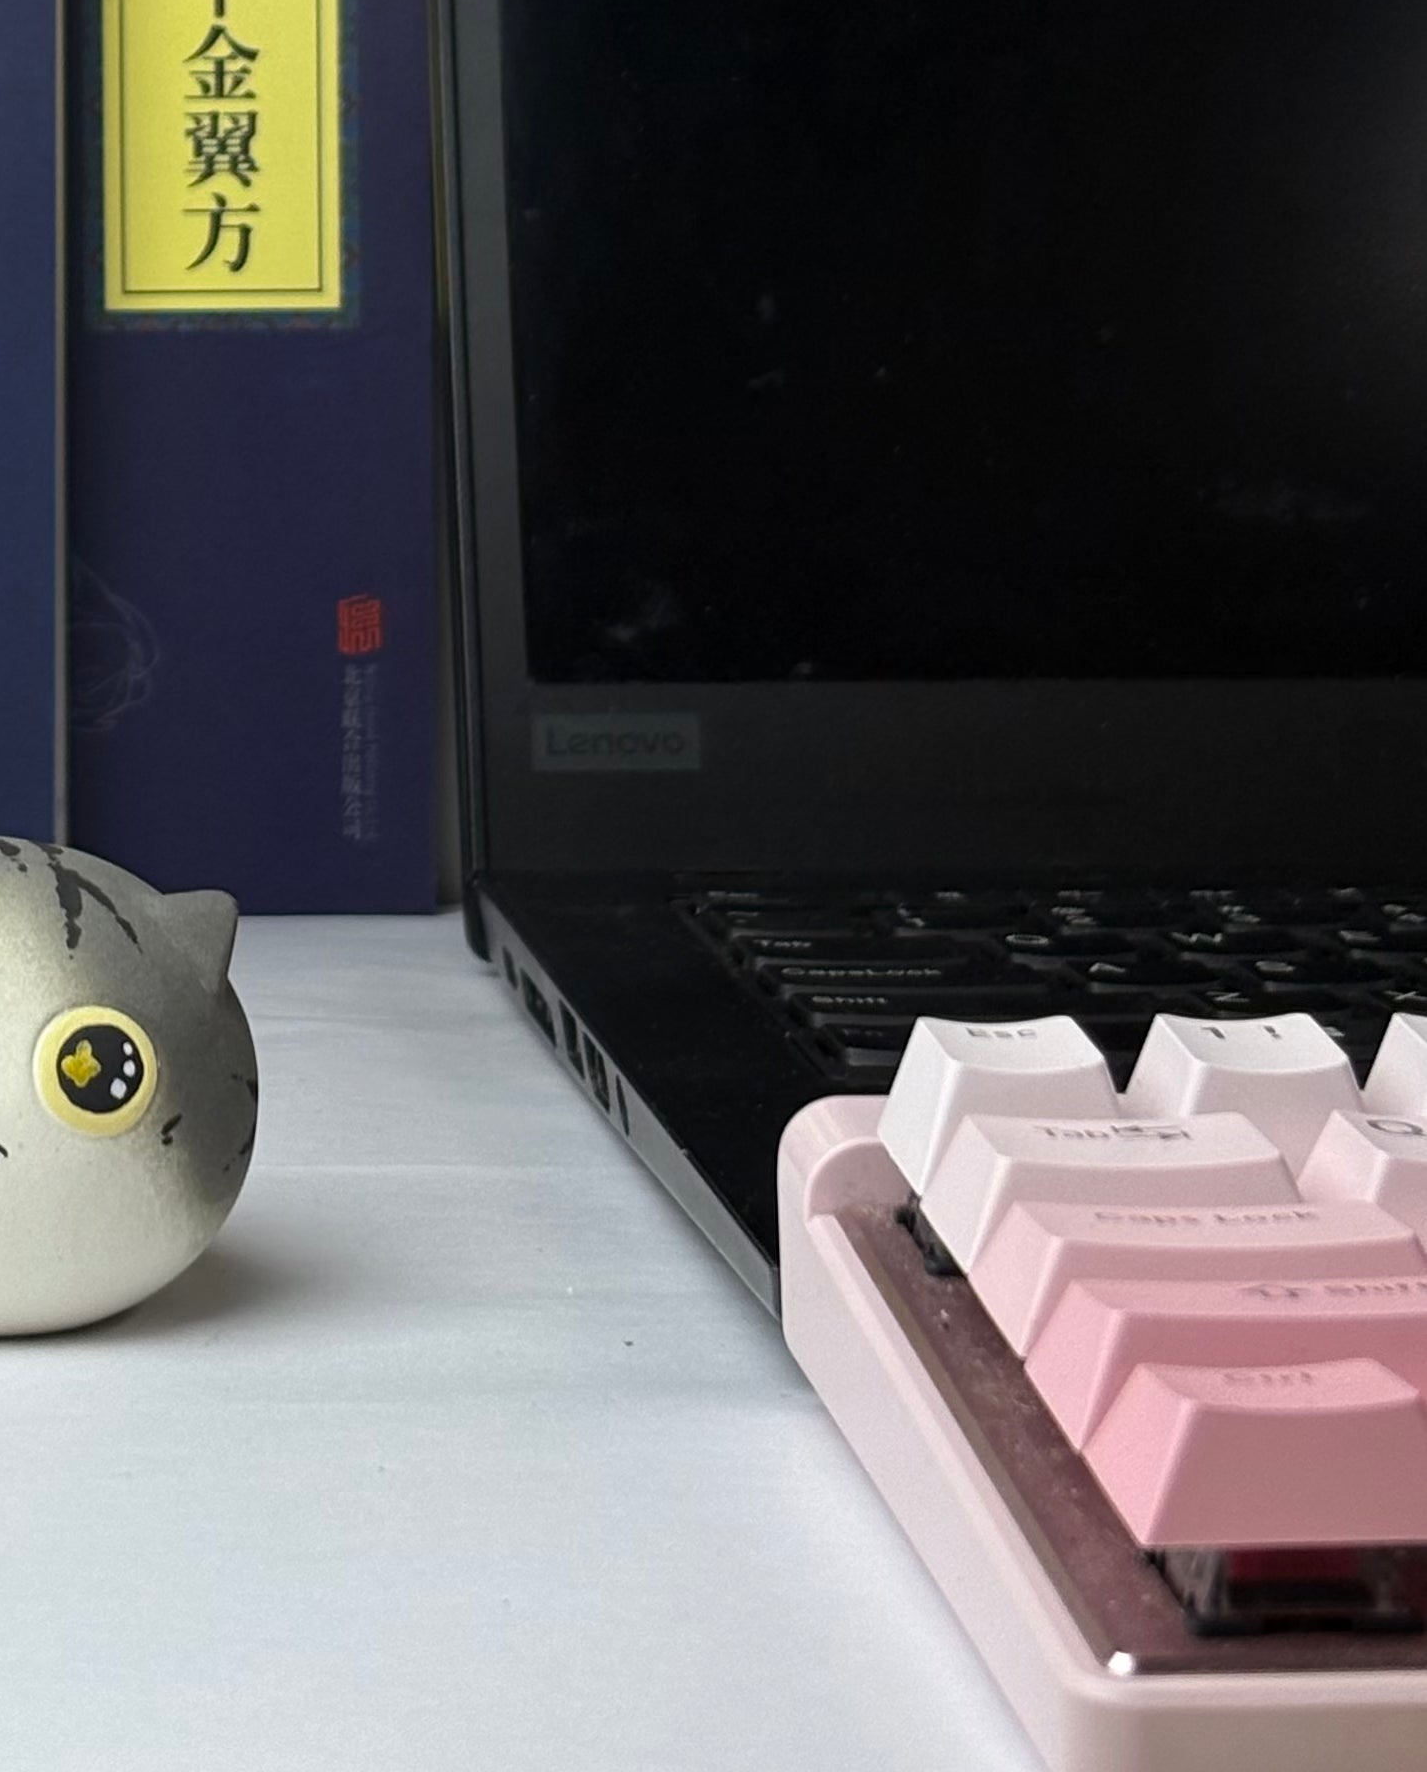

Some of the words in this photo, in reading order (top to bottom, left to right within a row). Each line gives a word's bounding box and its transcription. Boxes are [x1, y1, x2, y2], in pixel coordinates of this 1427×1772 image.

[546, 724, 686, 756] Lenovo
[964, 1026, 1039, 1040] Esc
[1033, 1126, 1111, 1141] Tab
[1368, 1118, 1427, 1136] Q
[1094, 1211, 1201, 1226] Caps
[1213, 1209, 1318, 1224] Lock
[1221, 1370, 1315, 1387] Ctrl
